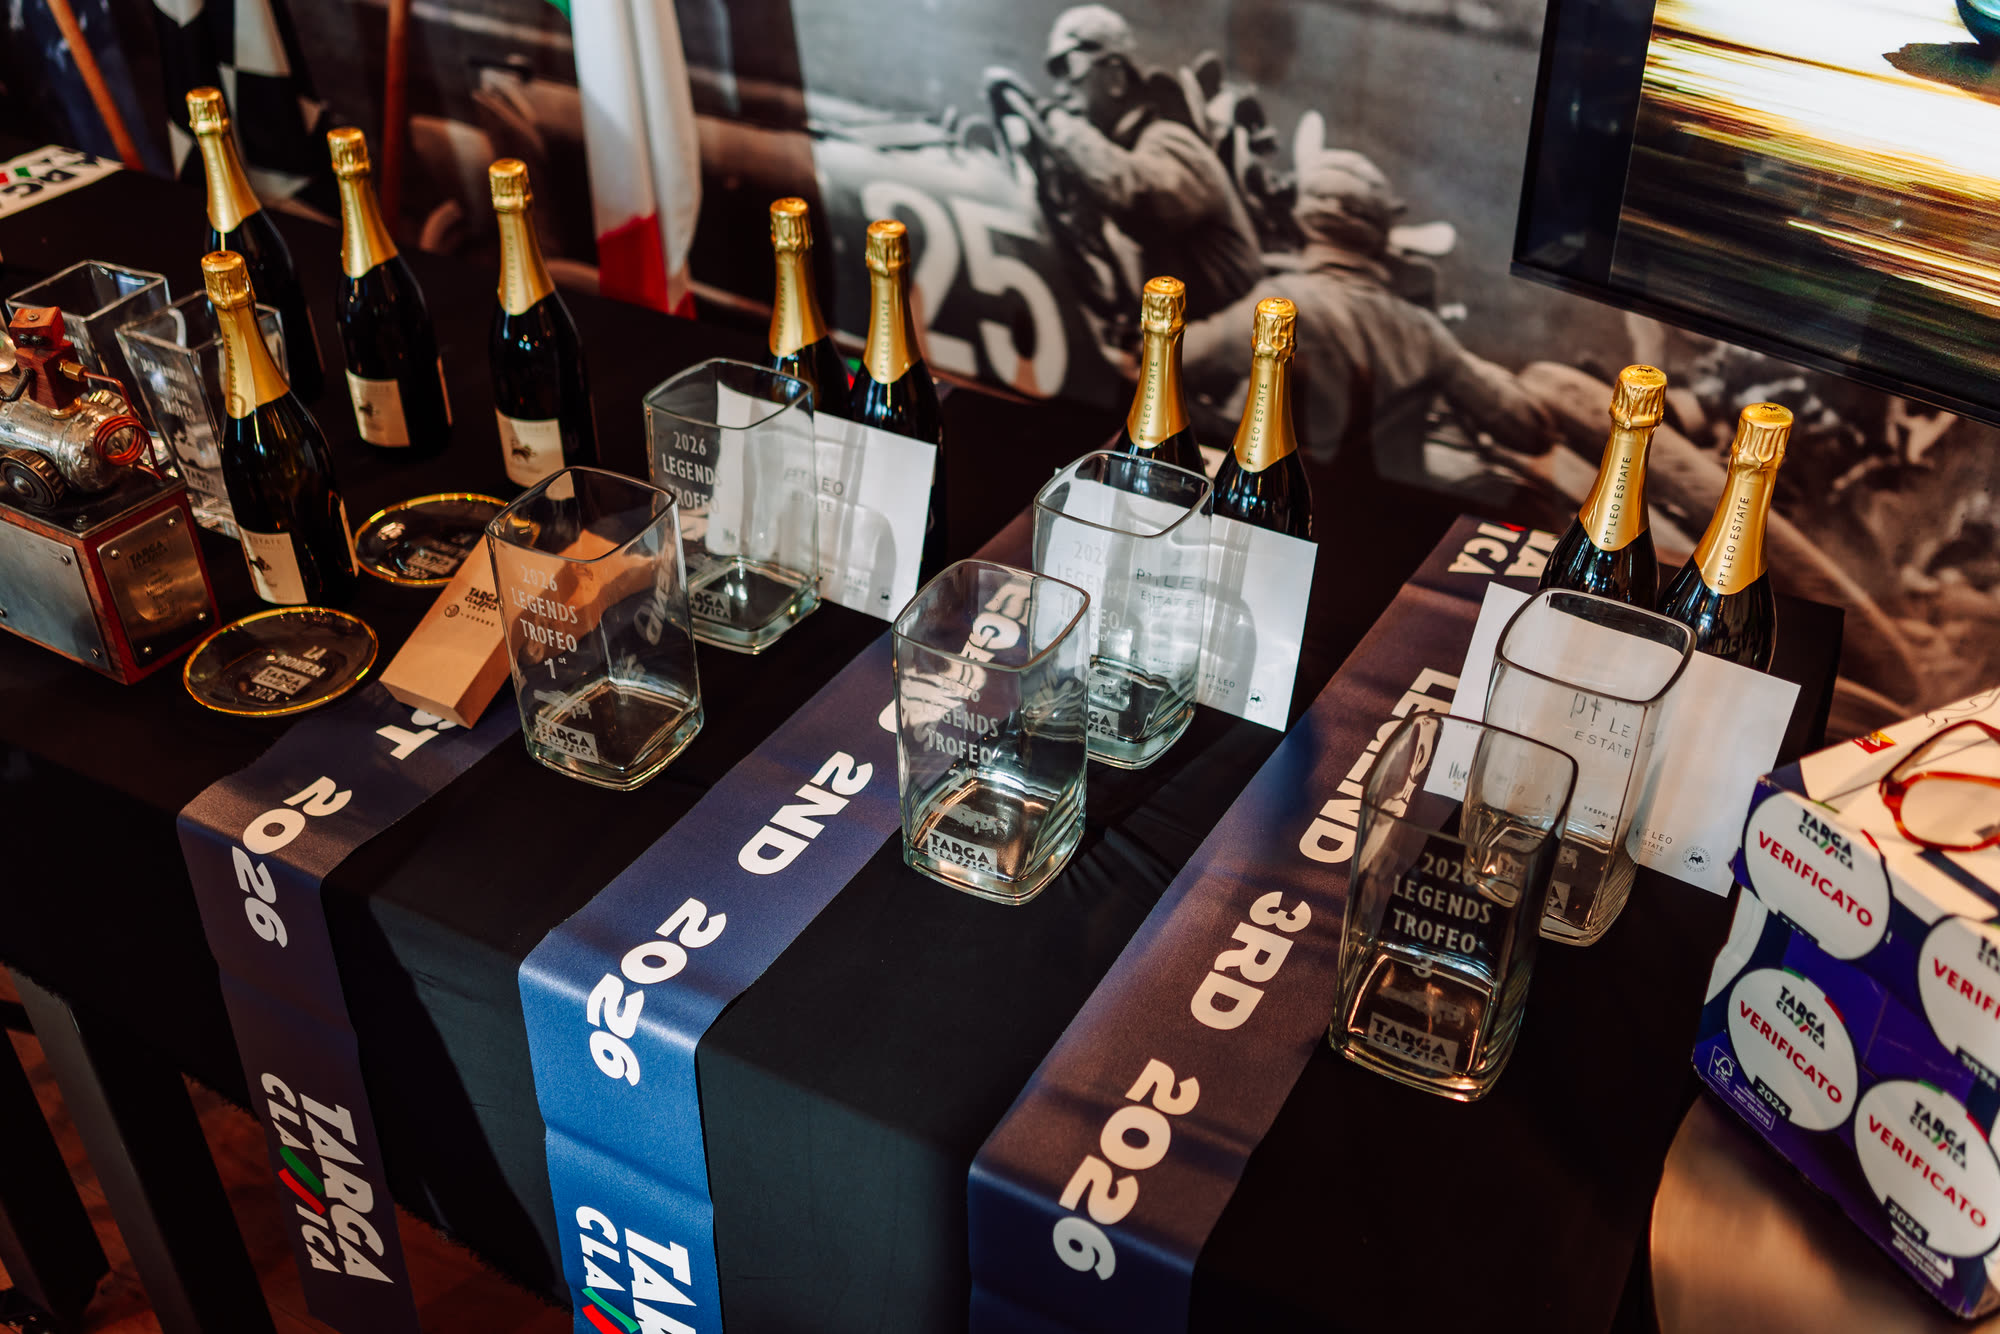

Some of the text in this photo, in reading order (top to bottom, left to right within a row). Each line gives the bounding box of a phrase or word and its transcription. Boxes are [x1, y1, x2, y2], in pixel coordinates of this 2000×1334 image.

[860, 182, 1071, 397] 25
[1146, 360, 1159, 399] ESTATE
[1143, 403, 1152, 425] LEO
[1254, 382, 1268, 422] ESTATE
[673, 431, 707, 457] 2026
[1251, 425, 1261, 452] LEO
[662, 452, 722, 488] LEGENDS
[1613, 456, 1632, 502] ESTATE
[1609, 502, 1620, 528] LEO
[1723, 541, 1736, 569] LEO
[1732, 496, 1750, 541] ESTATE
[469, 586, 498, 604] TARGA
[521, 564, 558, 592] 2026
[511, 586, 579, 625] LEGENDS
[519, 618, 578, 653] TROFEO
[926, 728, 993, 767] TROFEO
[1574, 730, 1632, 759] ESTATE
[929, 832, 990, 865] TARGA
[1651, 831, 1673, 845] LEO
[1801, 808, 1853, 858] TARGA
[231, 776, 352, 948] 2026
[1421, 851, 1477, 887] 2026
[1758, 830, 1873, 928] VERIFICATO
[586, 750, 874, 1087] 2ND 2026
[1393, 873, 1493, 925] LEGENDS
[1393, 908, 1477, 955] TROFEO
[1190, 891, 1312, 1031] 3RD
[1933, 957, 2000, 1021] VERIFI
[1779, 985, 1826, 1036] TARGA
[1373, 1018, 1447, 1058] TARGA
[1739, 1000, 1843, 1105] VERIFICATO
[1756, 1082, 1787, 1118] 2024
[1913, 1100, 1967, 1157] TARGA
[299, 1092, 395, 1285] TARGA
[1052, 1057, 1201, 1281] 2026
[1867, 1113, 1987, 1230] VERIFICATO
